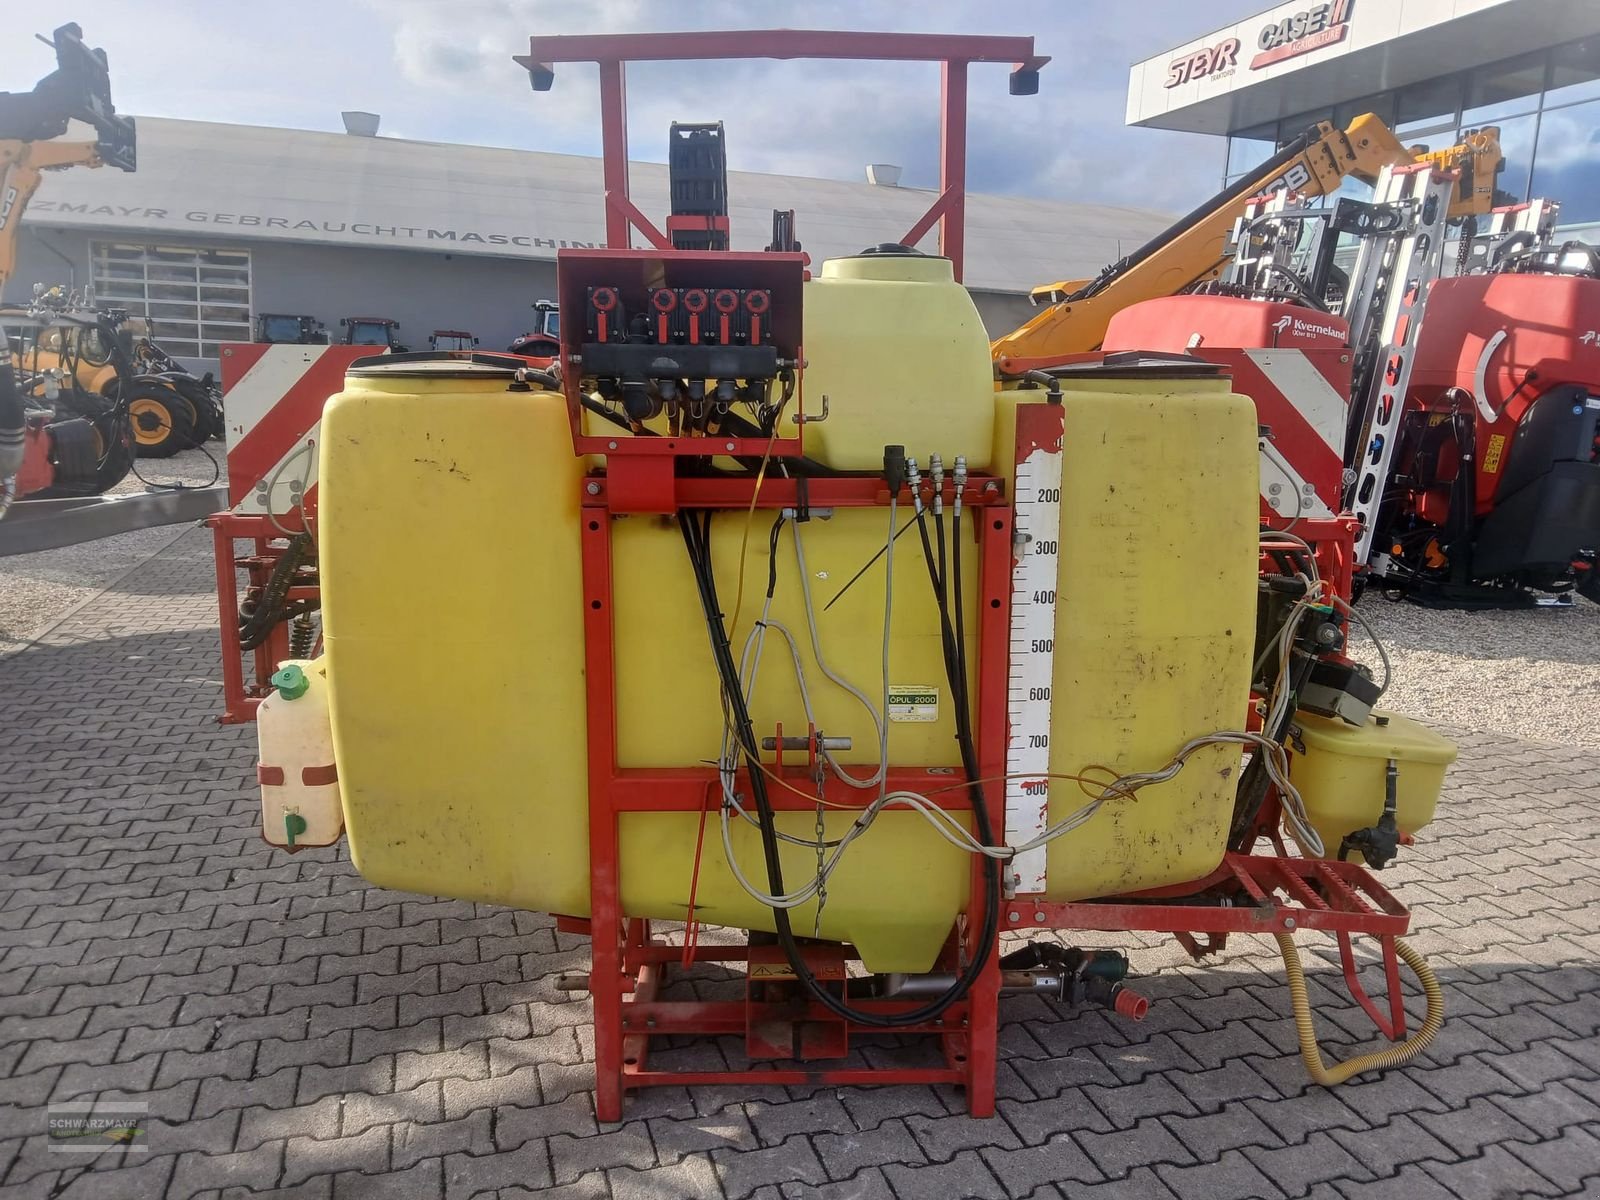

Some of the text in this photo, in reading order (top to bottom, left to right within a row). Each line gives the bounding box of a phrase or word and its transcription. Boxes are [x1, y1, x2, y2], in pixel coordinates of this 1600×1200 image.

[1257, 4, 1330, 51] CASE
[1164, 37, 1241, 89] STEYR
[1294, 319, 1346, 340] Kverneland
[1038, 488, 1060, 503] 200
[1035, 541, 1057, 555] 300
[1033, 590, 1055, 604] 400
[1031, 639, 1053, 653] 500
[914, 696, 936, 704] 2000
[1029, 687, 1050, 701] 600
[1028, 734, 1048, 748] 700
